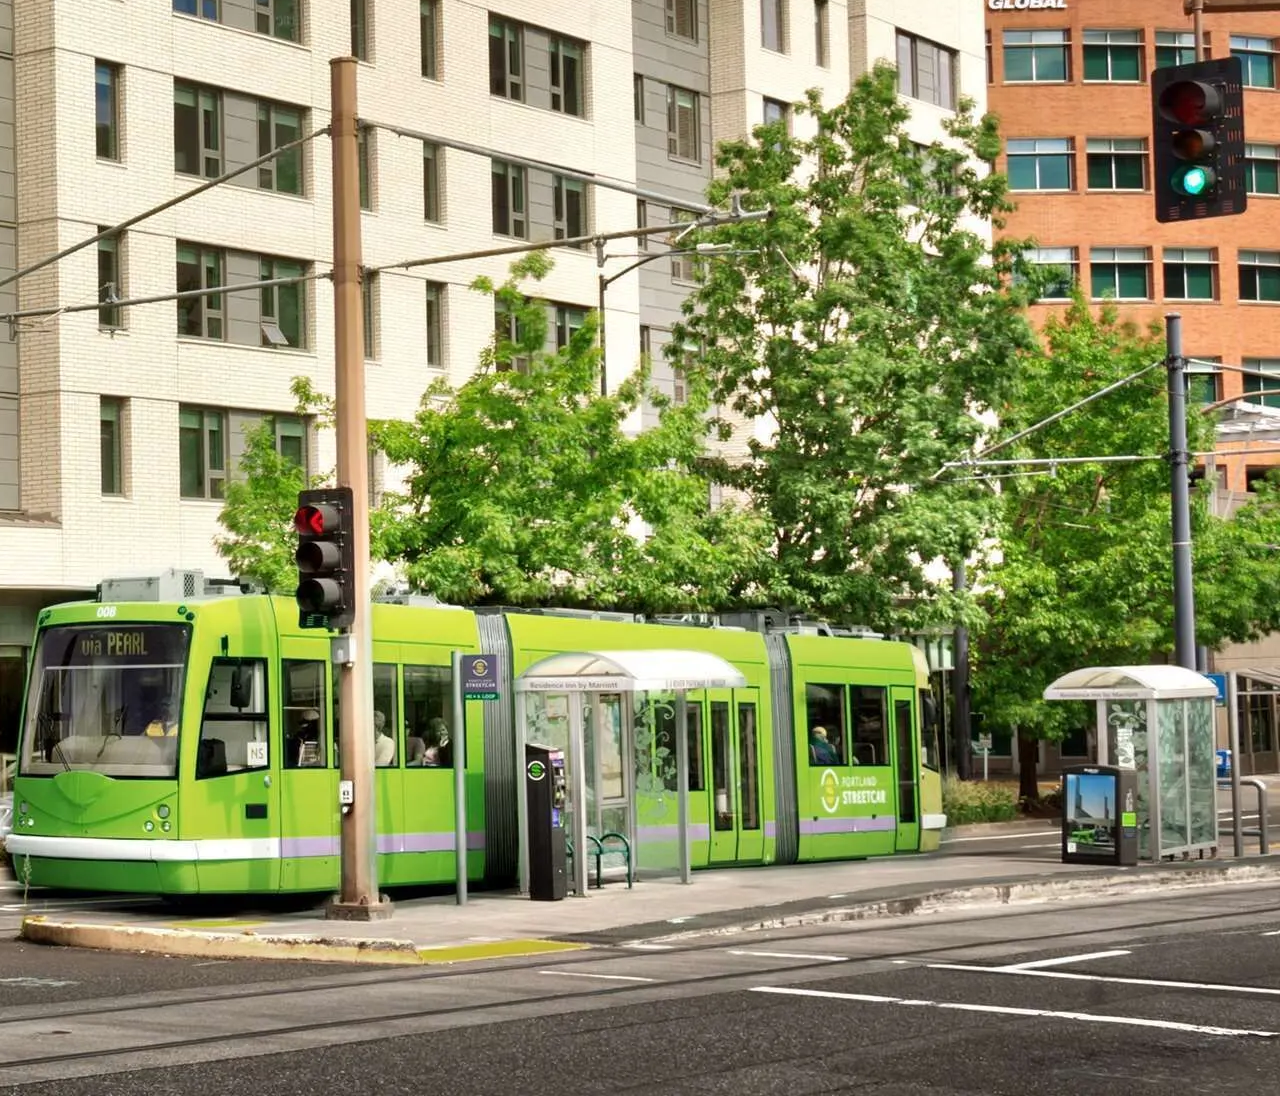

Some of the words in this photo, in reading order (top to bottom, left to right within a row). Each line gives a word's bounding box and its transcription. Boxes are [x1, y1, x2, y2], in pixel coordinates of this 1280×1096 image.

[81, 634, 102, 656] via
[107, 632, 149, 656] PEARL
[588, 681, 618, 689] Marriott
[251, 747, 264, 760] NS
[842, 776, 878, 787] PORTLAND
[842, 790, 886, 805] STREETCAR
